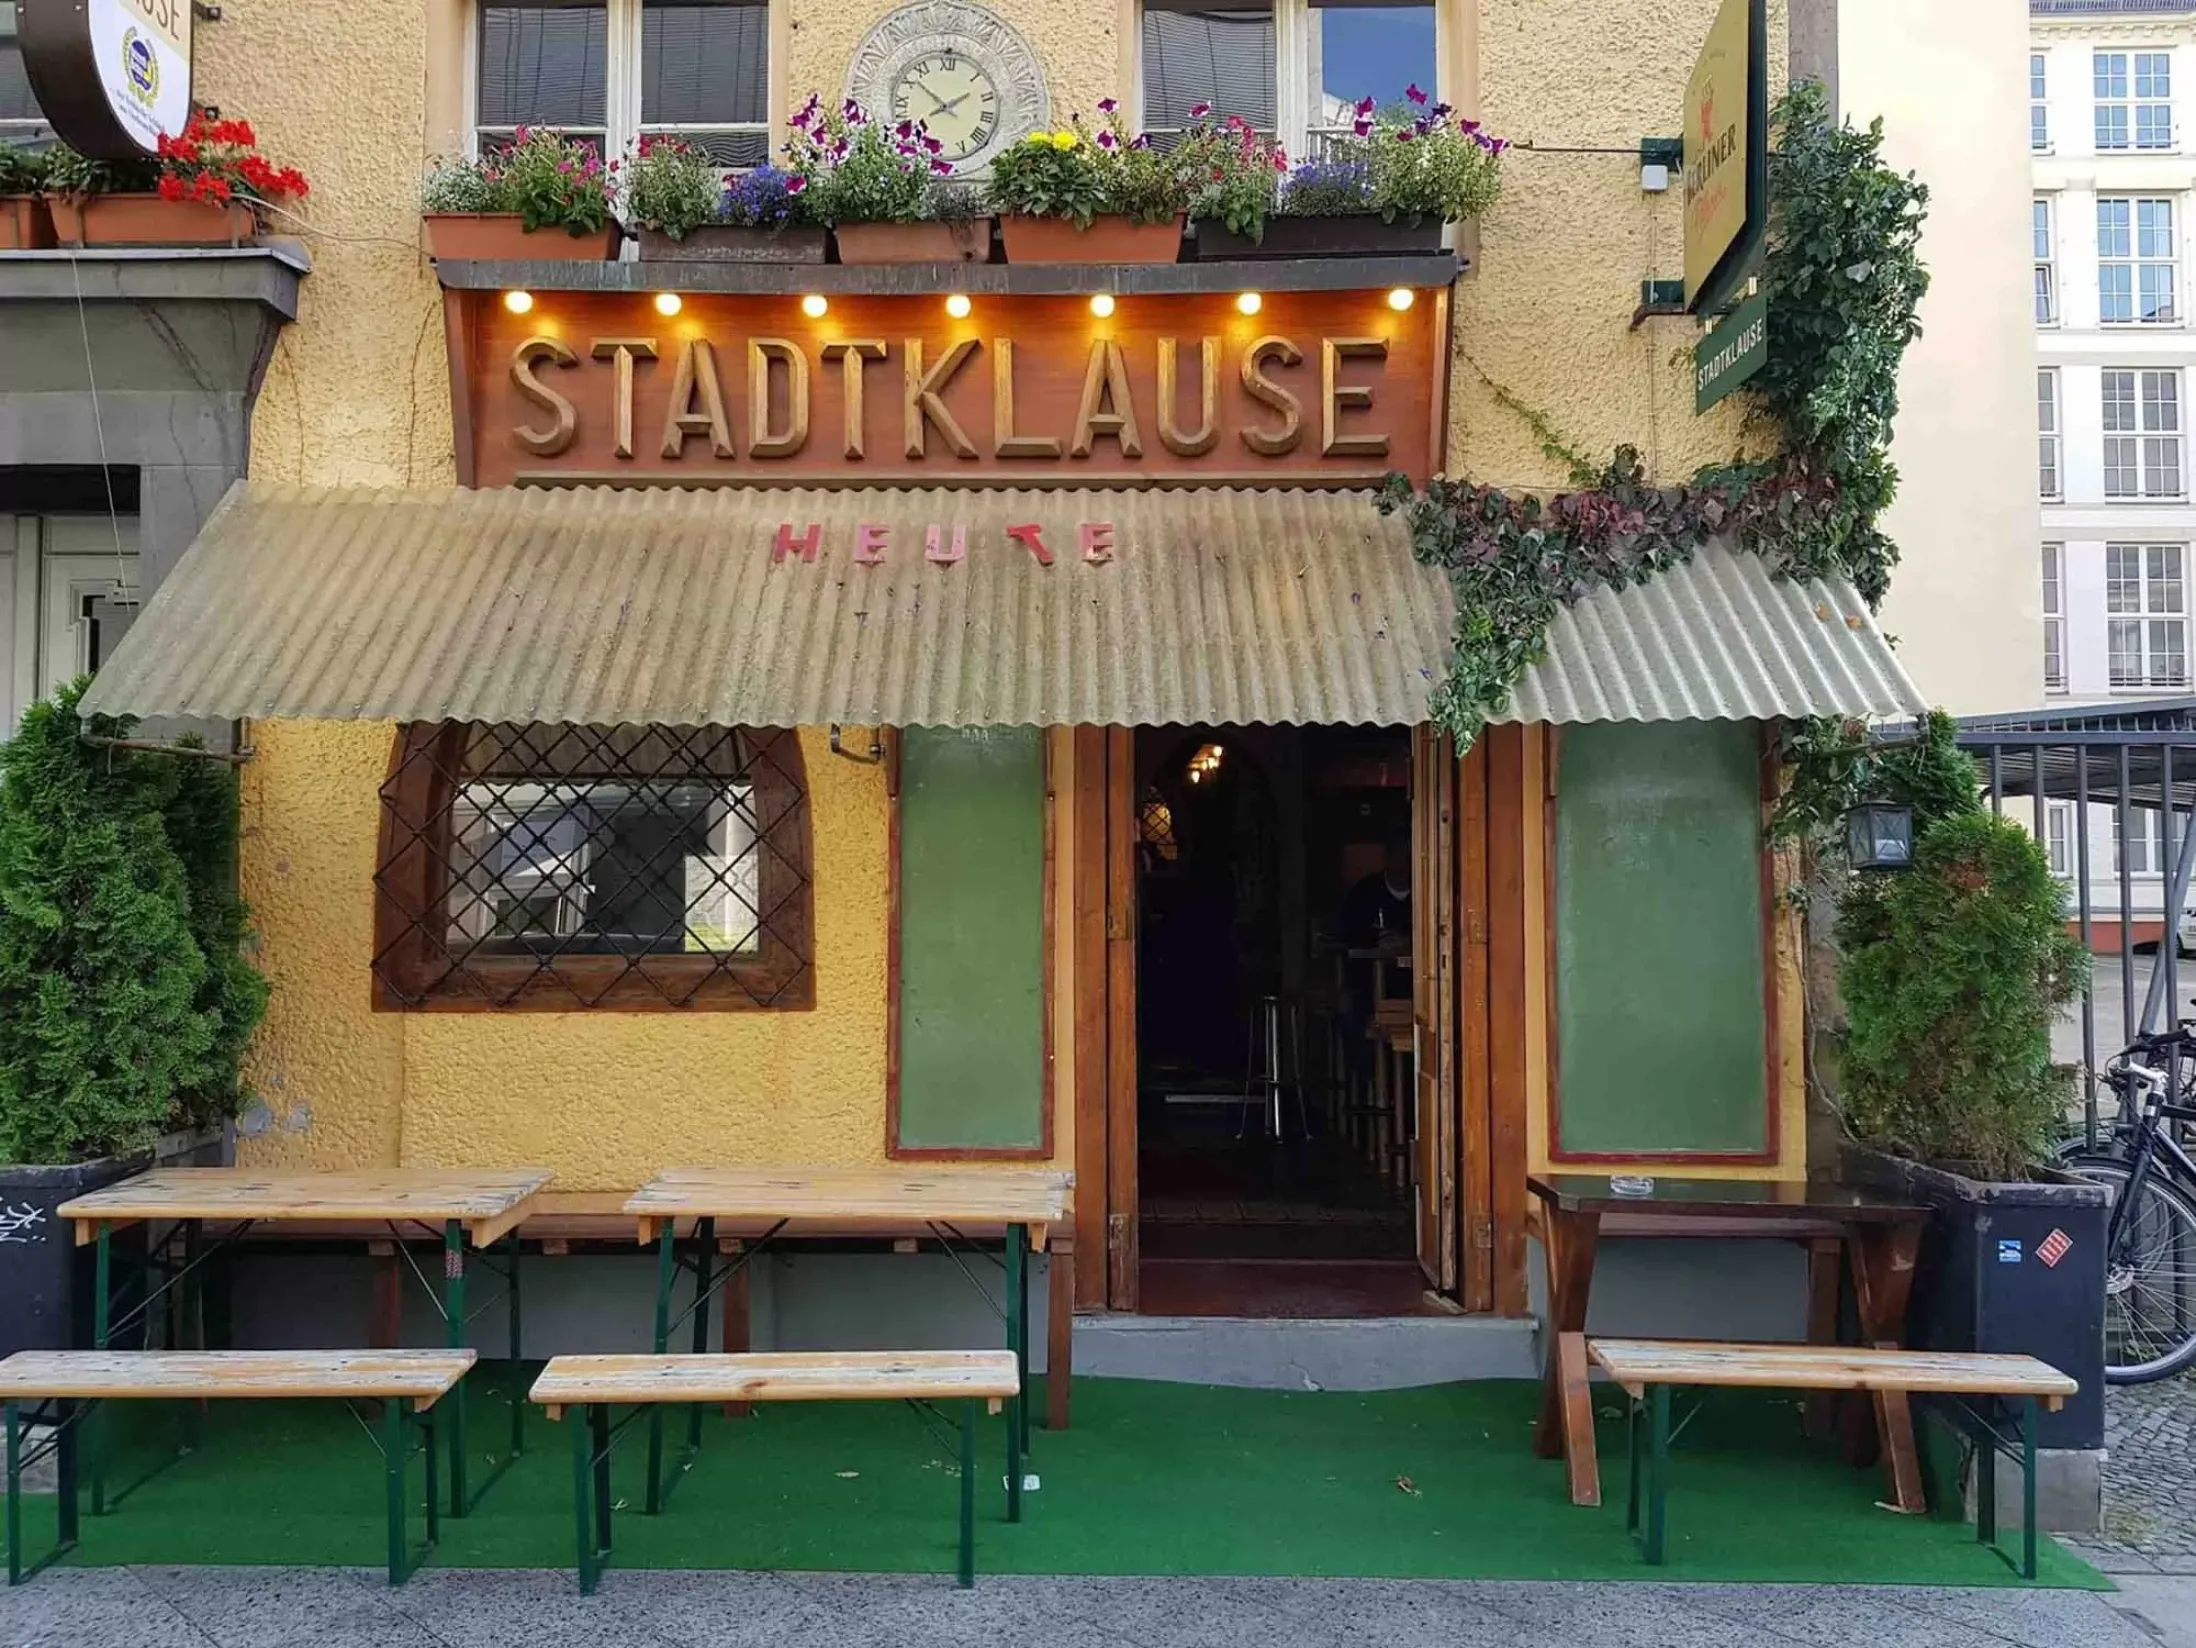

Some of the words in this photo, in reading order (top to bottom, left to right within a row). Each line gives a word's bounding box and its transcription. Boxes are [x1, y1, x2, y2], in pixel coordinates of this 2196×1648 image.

[1698, 317, 1762, 392] STADTKLAUSE
[509, 335, 1391, 459] STADTKLAUSE
[772, 523, 1115, 569] HEUTE
